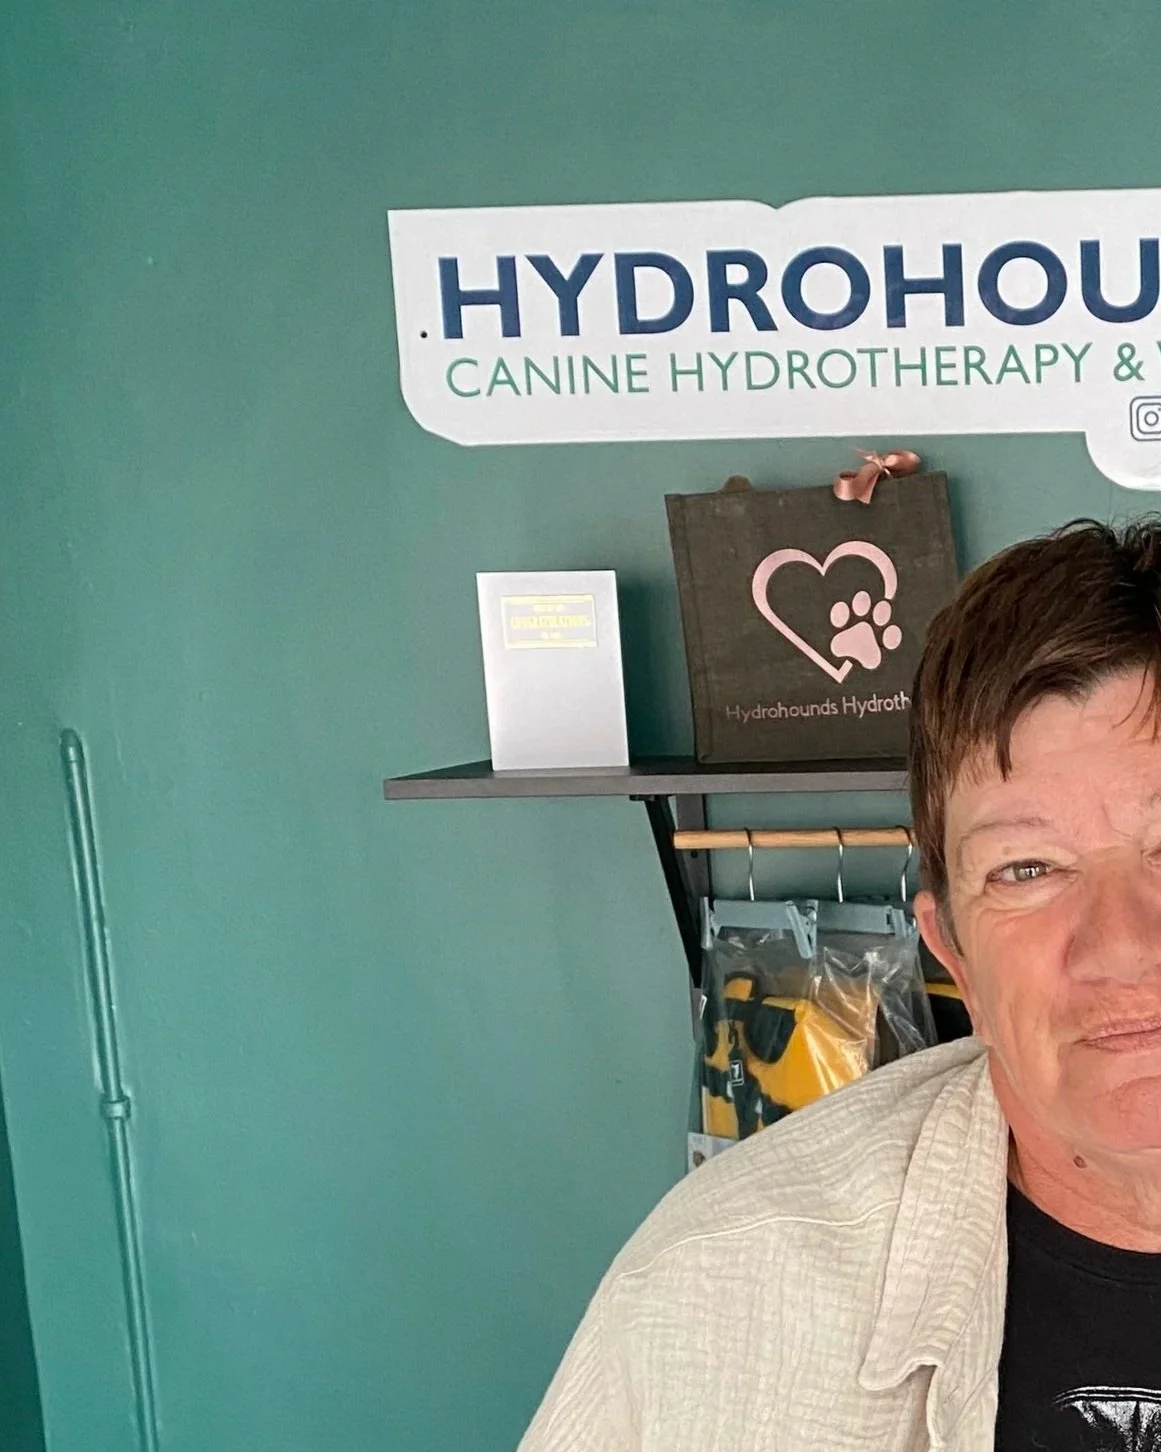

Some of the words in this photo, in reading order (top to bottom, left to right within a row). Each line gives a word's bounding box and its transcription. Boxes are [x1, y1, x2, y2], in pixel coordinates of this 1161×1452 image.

[446, 353, 651, 398] CANINE
[669, 342, 1092, 392] HYDROTHERAPY
[1112, 342, 1145, 382] &
[726, 698, 839, 723] Hydrohounds
